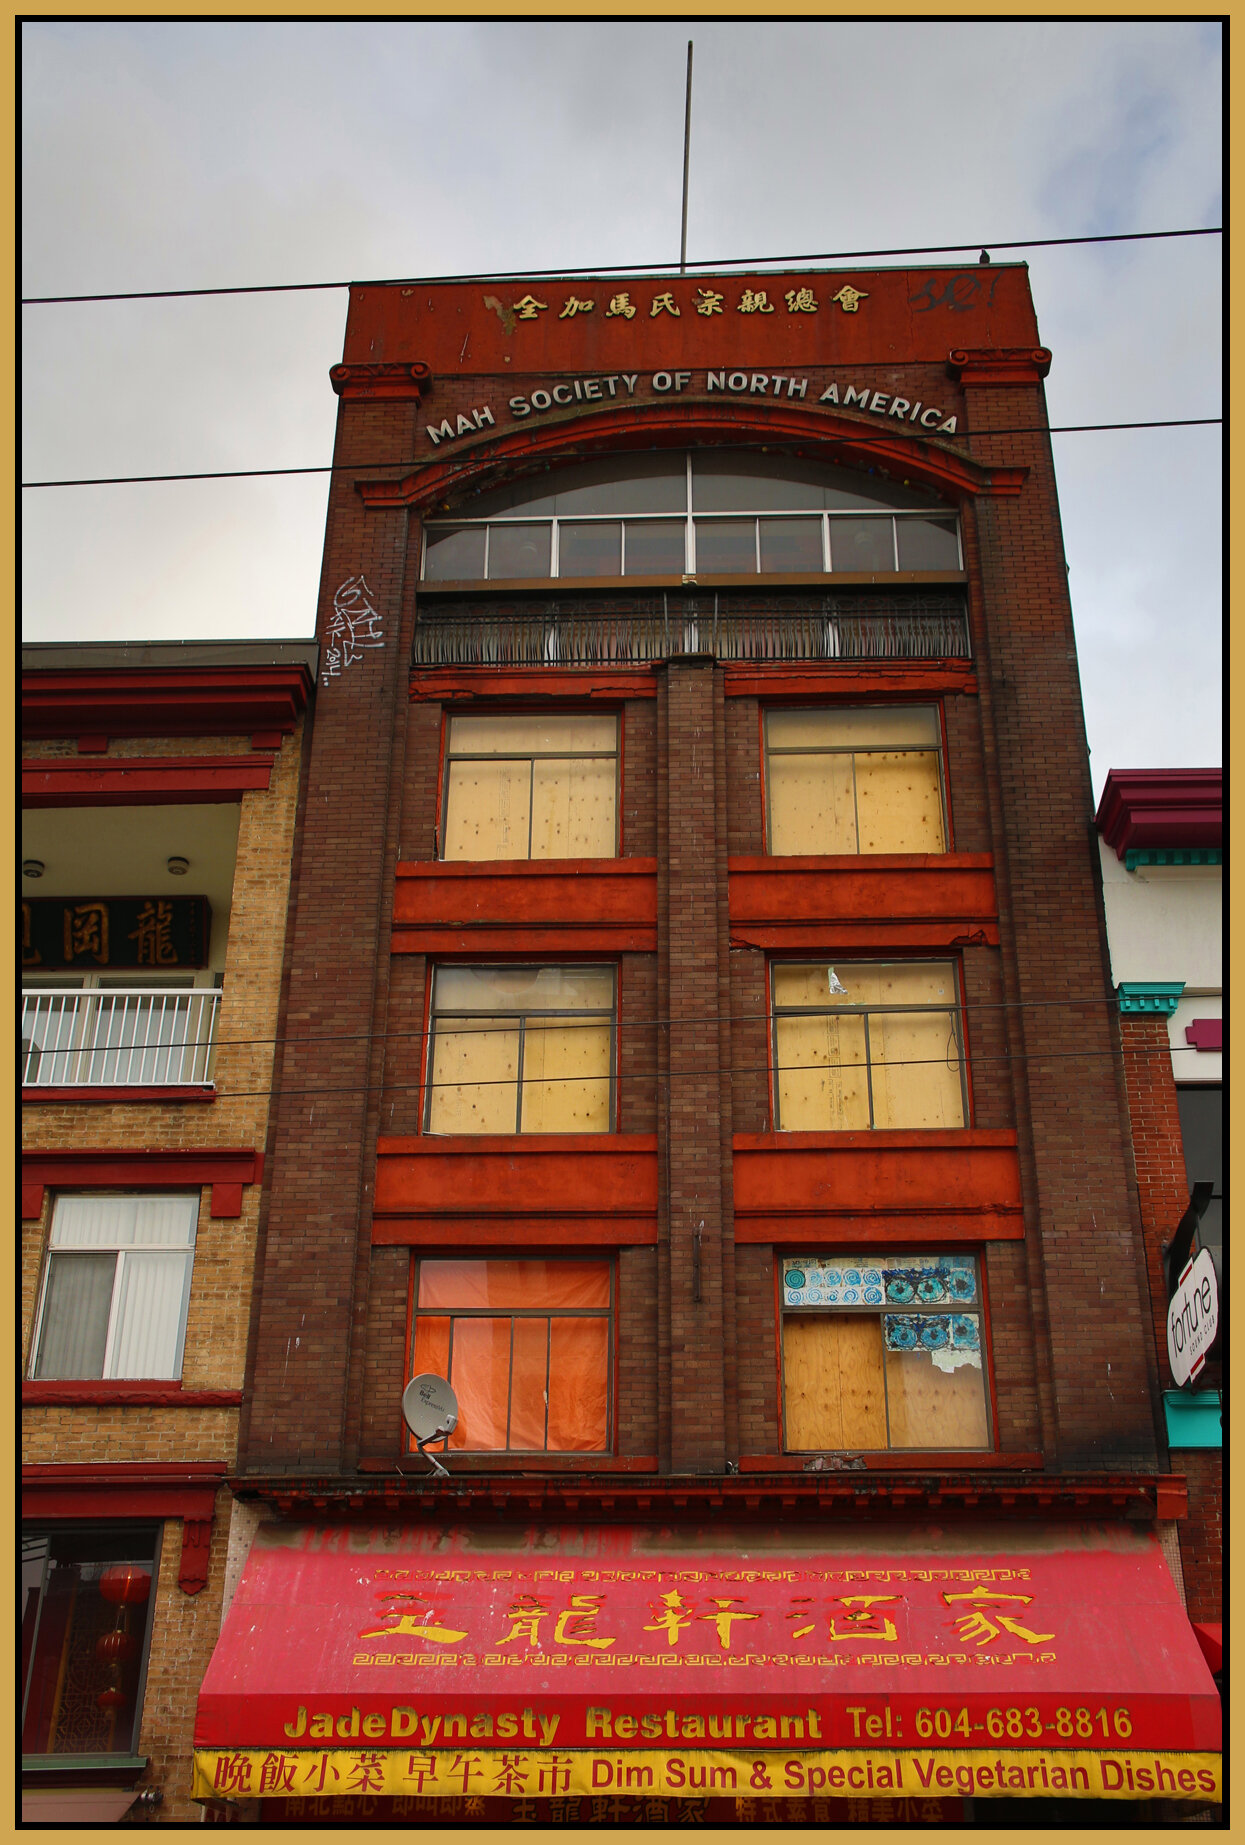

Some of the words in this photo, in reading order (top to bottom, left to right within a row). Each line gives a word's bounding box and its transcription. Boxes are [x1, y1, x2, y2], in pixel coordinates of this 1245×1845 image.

[426, 405, 496, 445] MAH
[509, 374, 638, 417] SOCIETY
[652, 371, 691, 392] OF
[707, 371, 808, 399] NORTH
[819, 383, 958, 435] AMERICA
[1171, 1276, 1212, 1358] fortune
[585, 1706, 822, 1738] Restaurant
[846, 1706, 903, 1738] Tel:
[915, 1706, 1133, 1738] 604-683-8816
[213, 1753, 388, 1793] 晚飯小菜
[402, 1754, 574, 1795] 早午茶市
[591, 1759, 653, 1788] Dim
[665, 1758, 737, 1789] Sum
[749, 1760, 773, 1790] &
[783, 1759, 902, 1796] Special
[912, 1758, 1090, 1796] Vegetarian
[1100, 1759, 1216, 1792] Dishes
